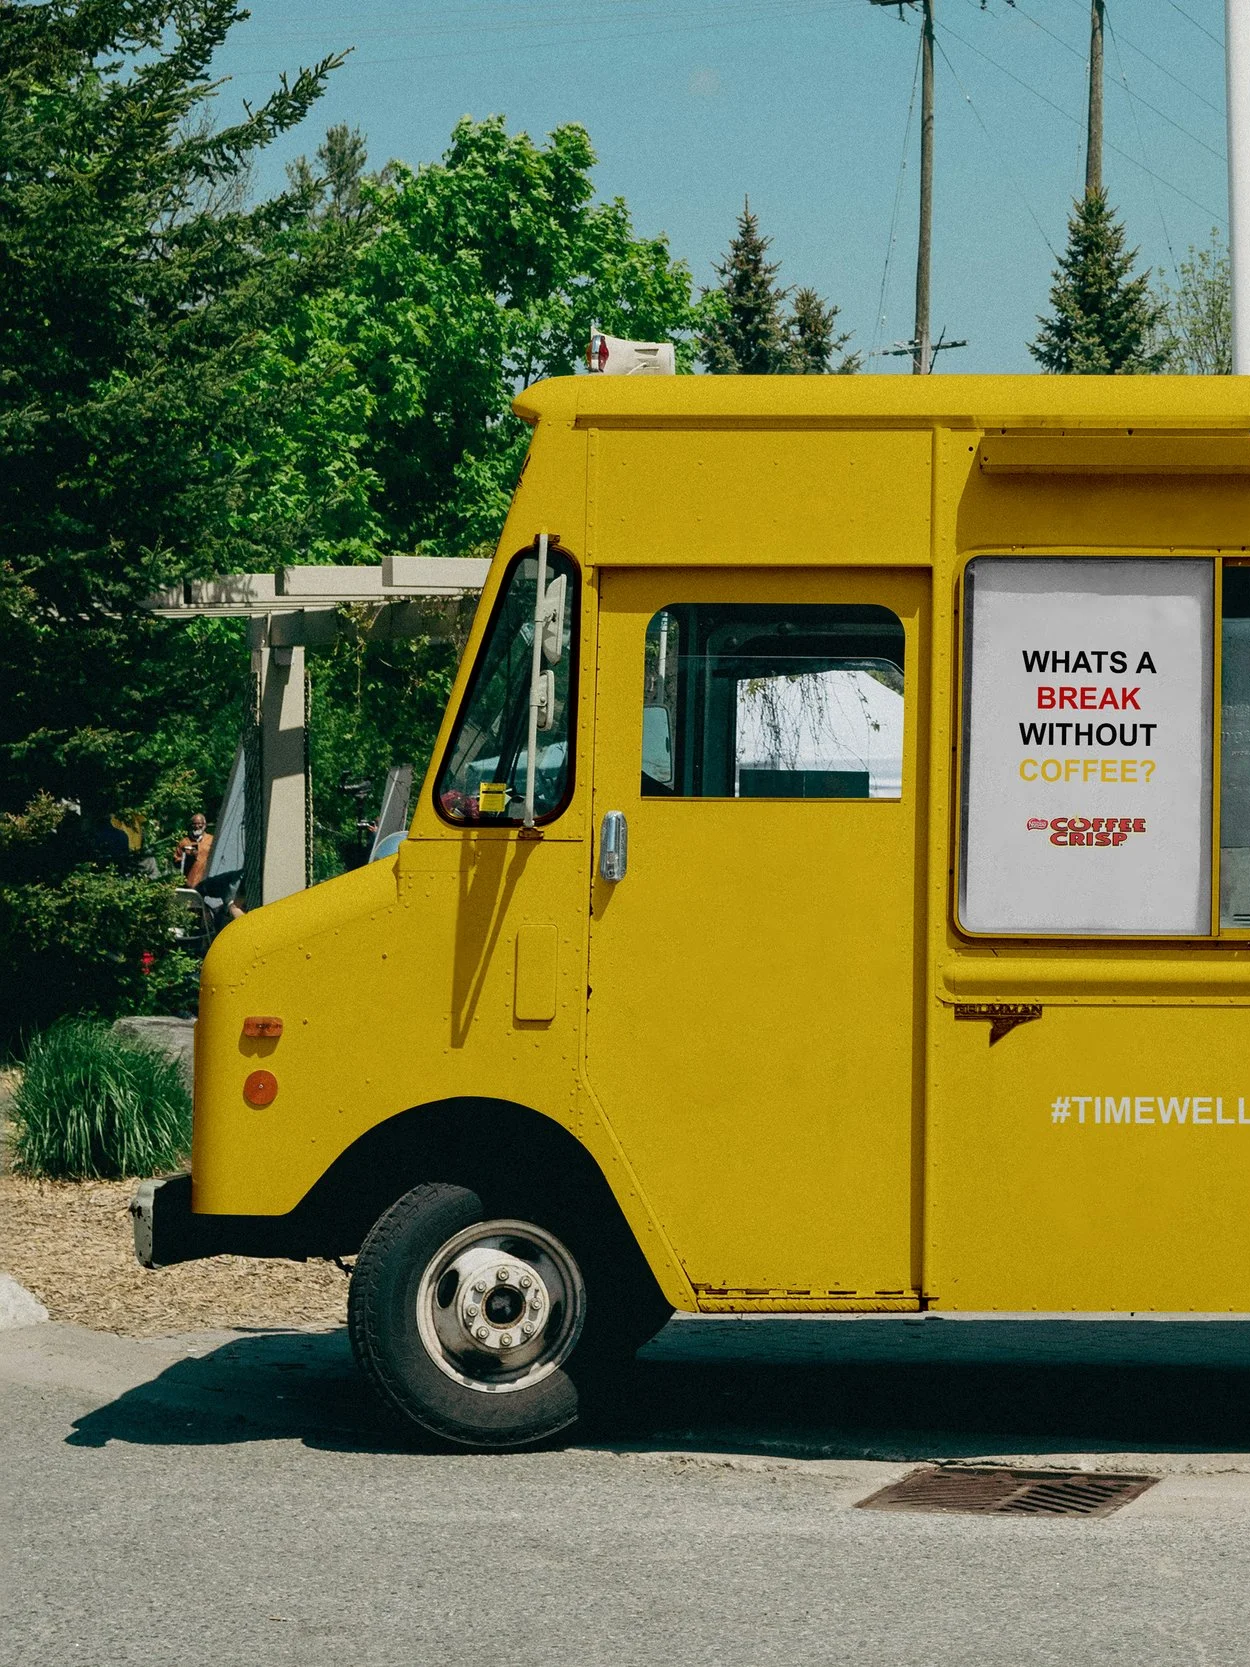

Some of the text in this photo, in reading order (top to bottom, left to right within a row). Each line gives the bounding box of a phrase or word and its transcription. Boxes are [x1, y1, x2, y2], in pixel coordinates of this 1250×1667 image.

[1022, 651, 1158, 674] WHATS A
[1036, 686, 1141, 711] BREAK
[1019, 723, 1158, 747] WITHOUT
[1019, 758, 1157, 783] COFFEE?
[1050, 817, 1146, 832] COFFEE
